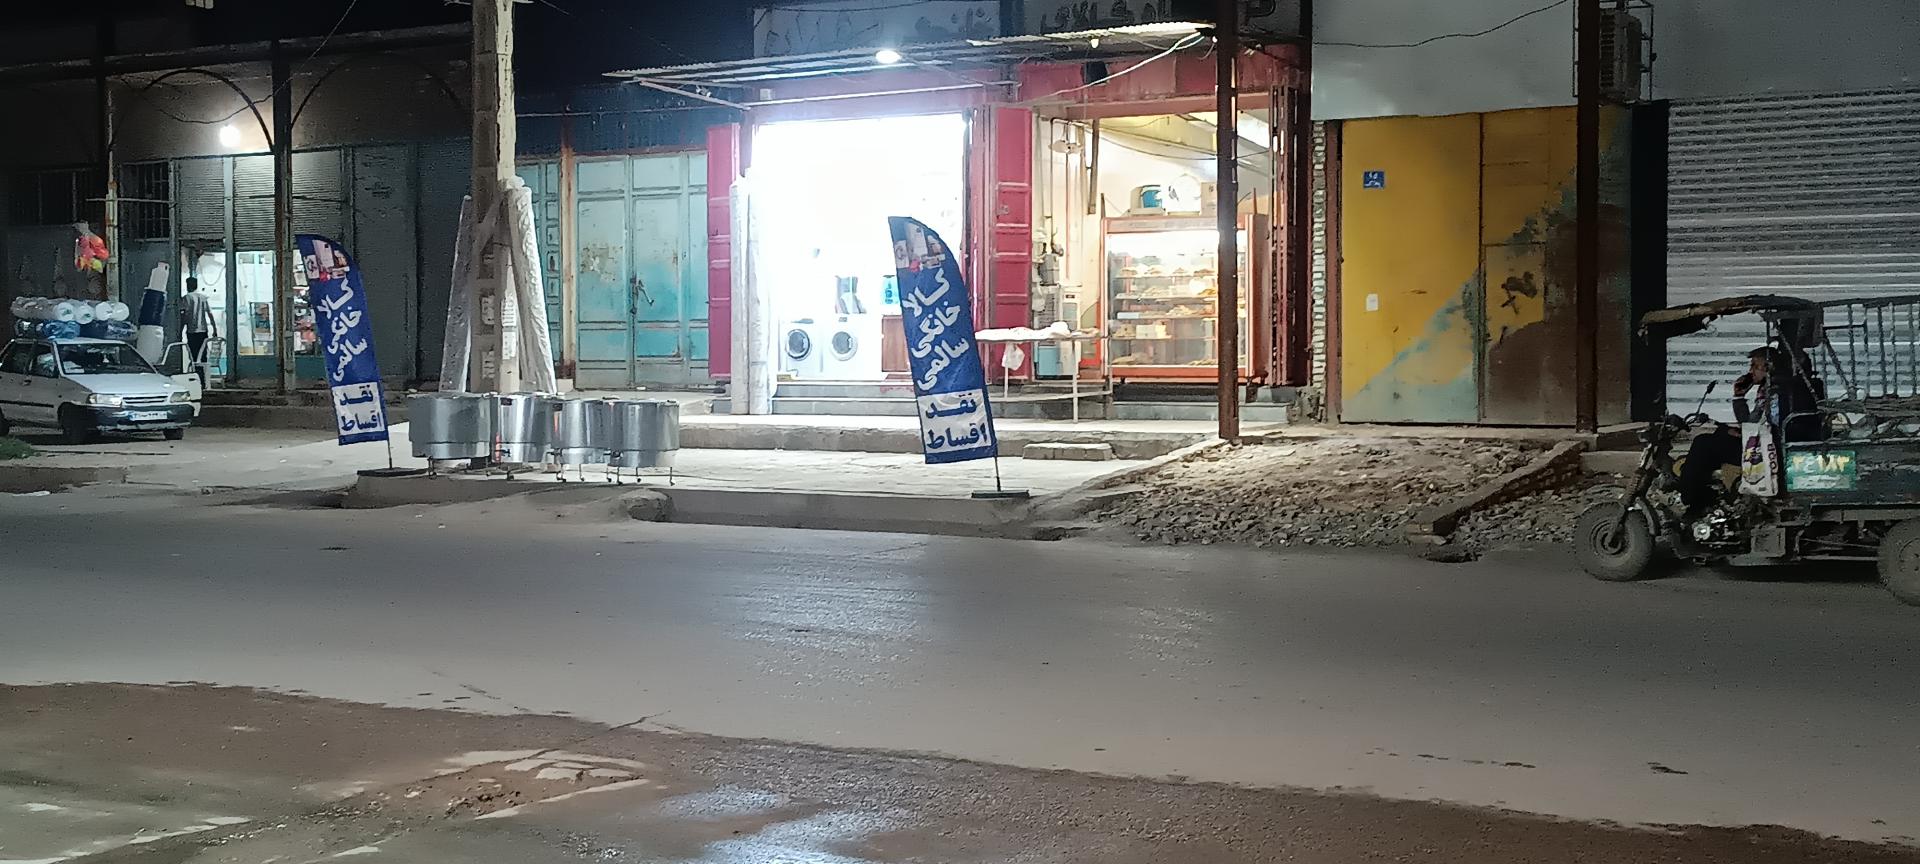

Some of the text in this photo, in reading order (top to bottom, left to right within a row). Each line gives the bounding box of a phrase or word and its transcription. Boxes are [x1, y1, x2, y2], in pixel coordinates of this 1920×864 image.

[317, 278, 355, 320] کالا
[902, 268, 951, 318] کالا
[327, 306, 363, 354] خانگی
[911, 301, 961, 358] خانگی
[333, 337, 368, 382] سالمی
[917, 336, 970, 391] سالمی
[339, 384, 374, 406] نقد
[925, 392, 977, 419] نقد
[341, 410, 382, 431] اقساط
[926, 422, 988, 450] اقساط
